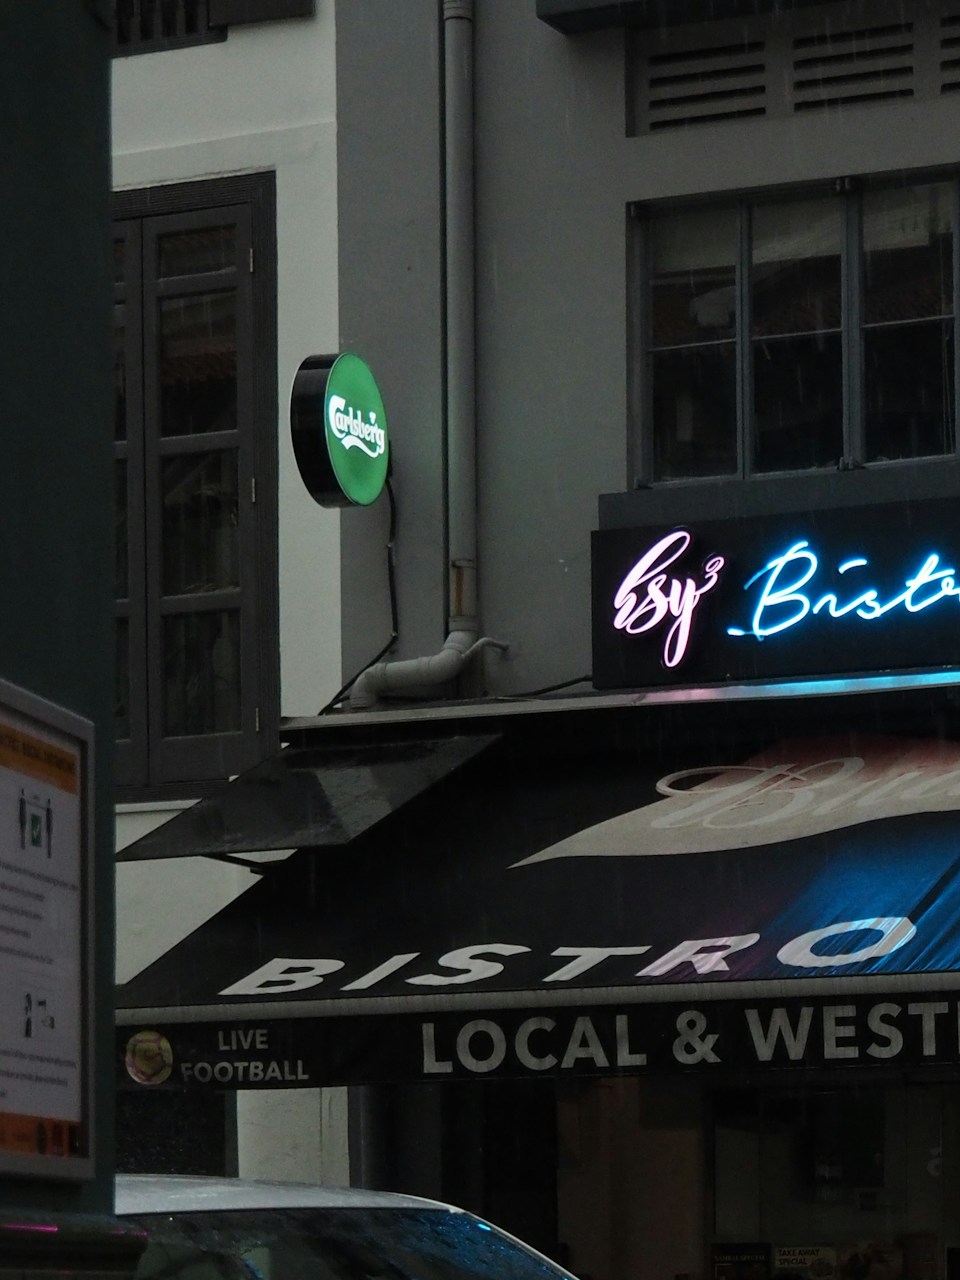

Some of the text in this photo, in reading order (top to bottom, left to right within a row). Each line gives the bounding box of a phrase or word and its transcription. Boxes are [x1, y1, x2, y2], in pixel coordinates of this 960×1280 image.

[328, 394, 385, 458] Carlsberg
[218, 915, 917, 996] BISTRO
[217, 1028, 270, 1052] LIVE
[420, 1014, 648, 1074] LOCAL
[672, 1009, 723, 1067] &
[180, 1058, 310, 1085] FOOTBALL
[778, 1257, 808, 1266] SPECIAL
[798, 1248, 820, 1257] AWAY
